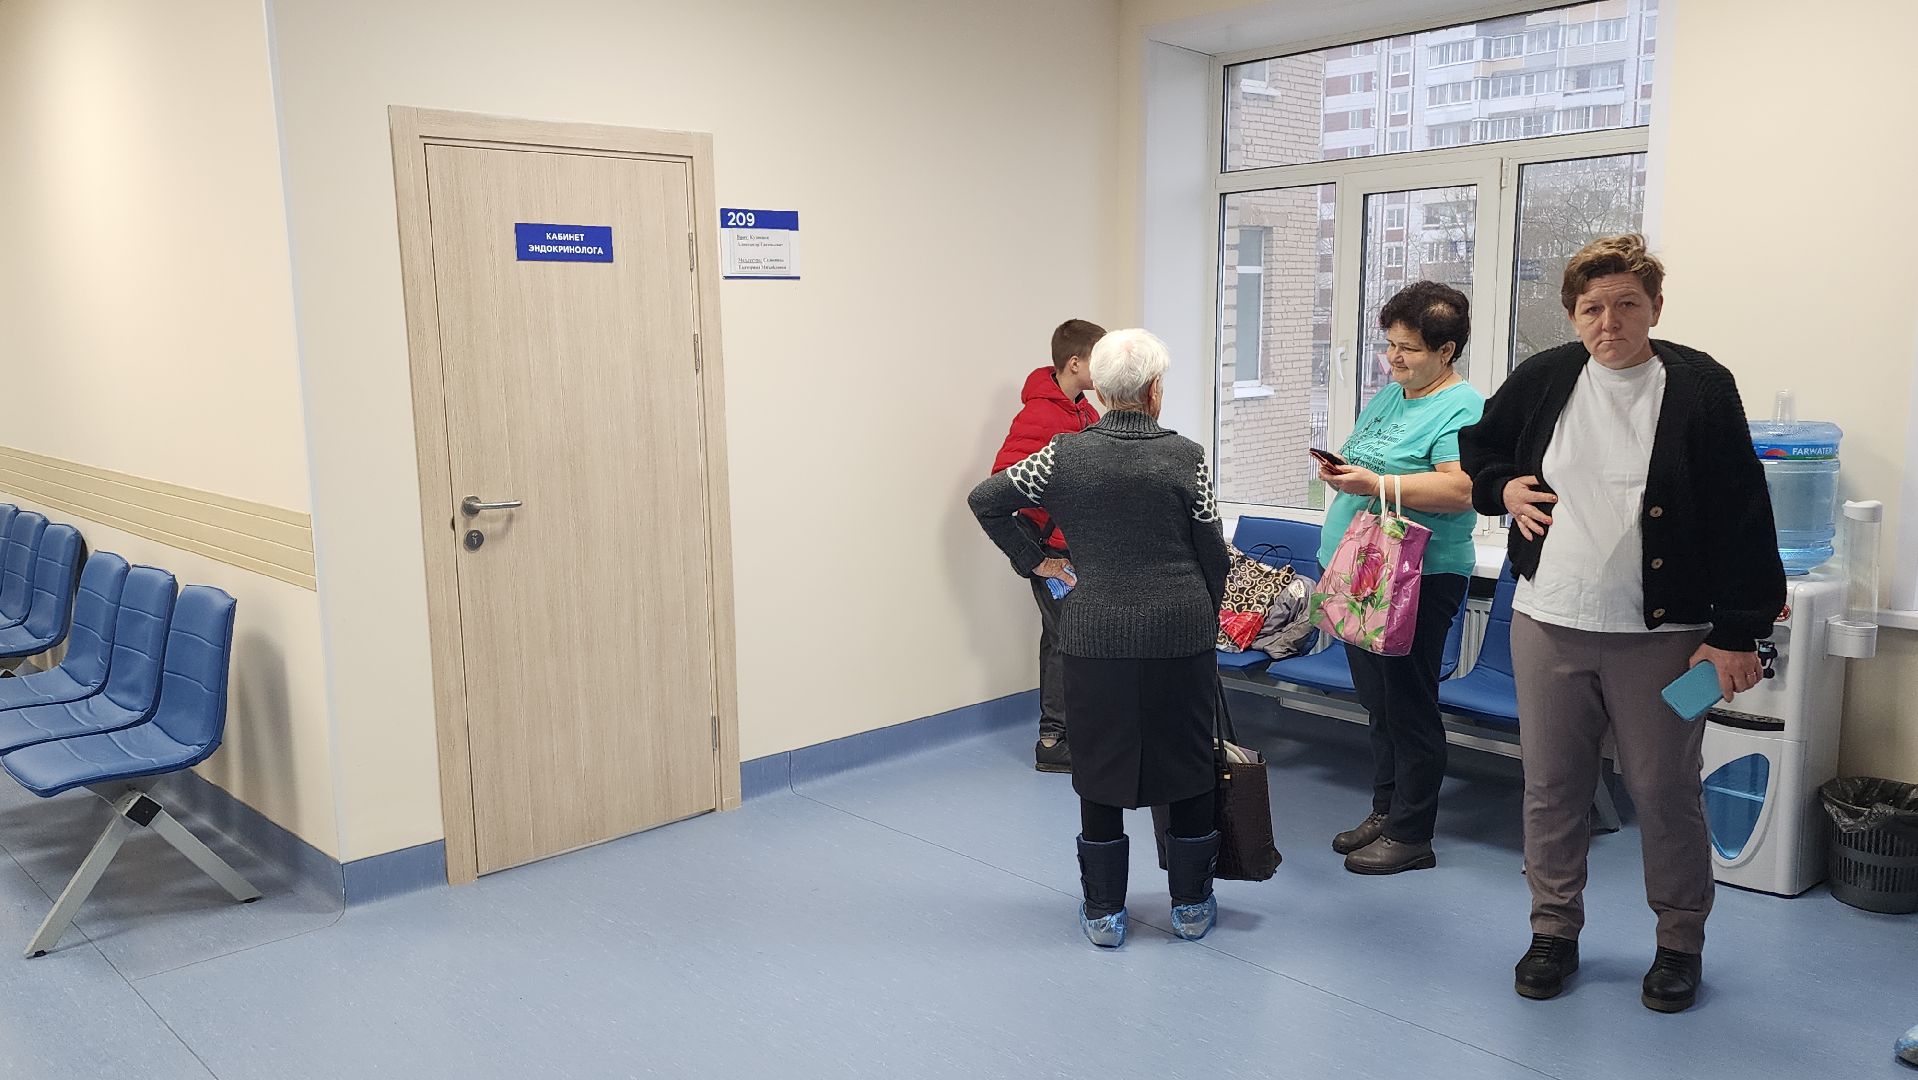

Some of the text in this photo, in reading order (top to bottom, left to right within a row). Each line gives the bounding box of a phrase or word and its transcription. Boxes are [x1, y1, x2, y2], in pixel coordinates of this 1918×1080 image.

[727, 212, 755, 226] 209
[545, 232, 585, 241] КАБИНЕТ
[528, 244, 604, 255] ЭНДОКРИНОЛОГА
[1792, 447, 1833, 456] FARWATER
